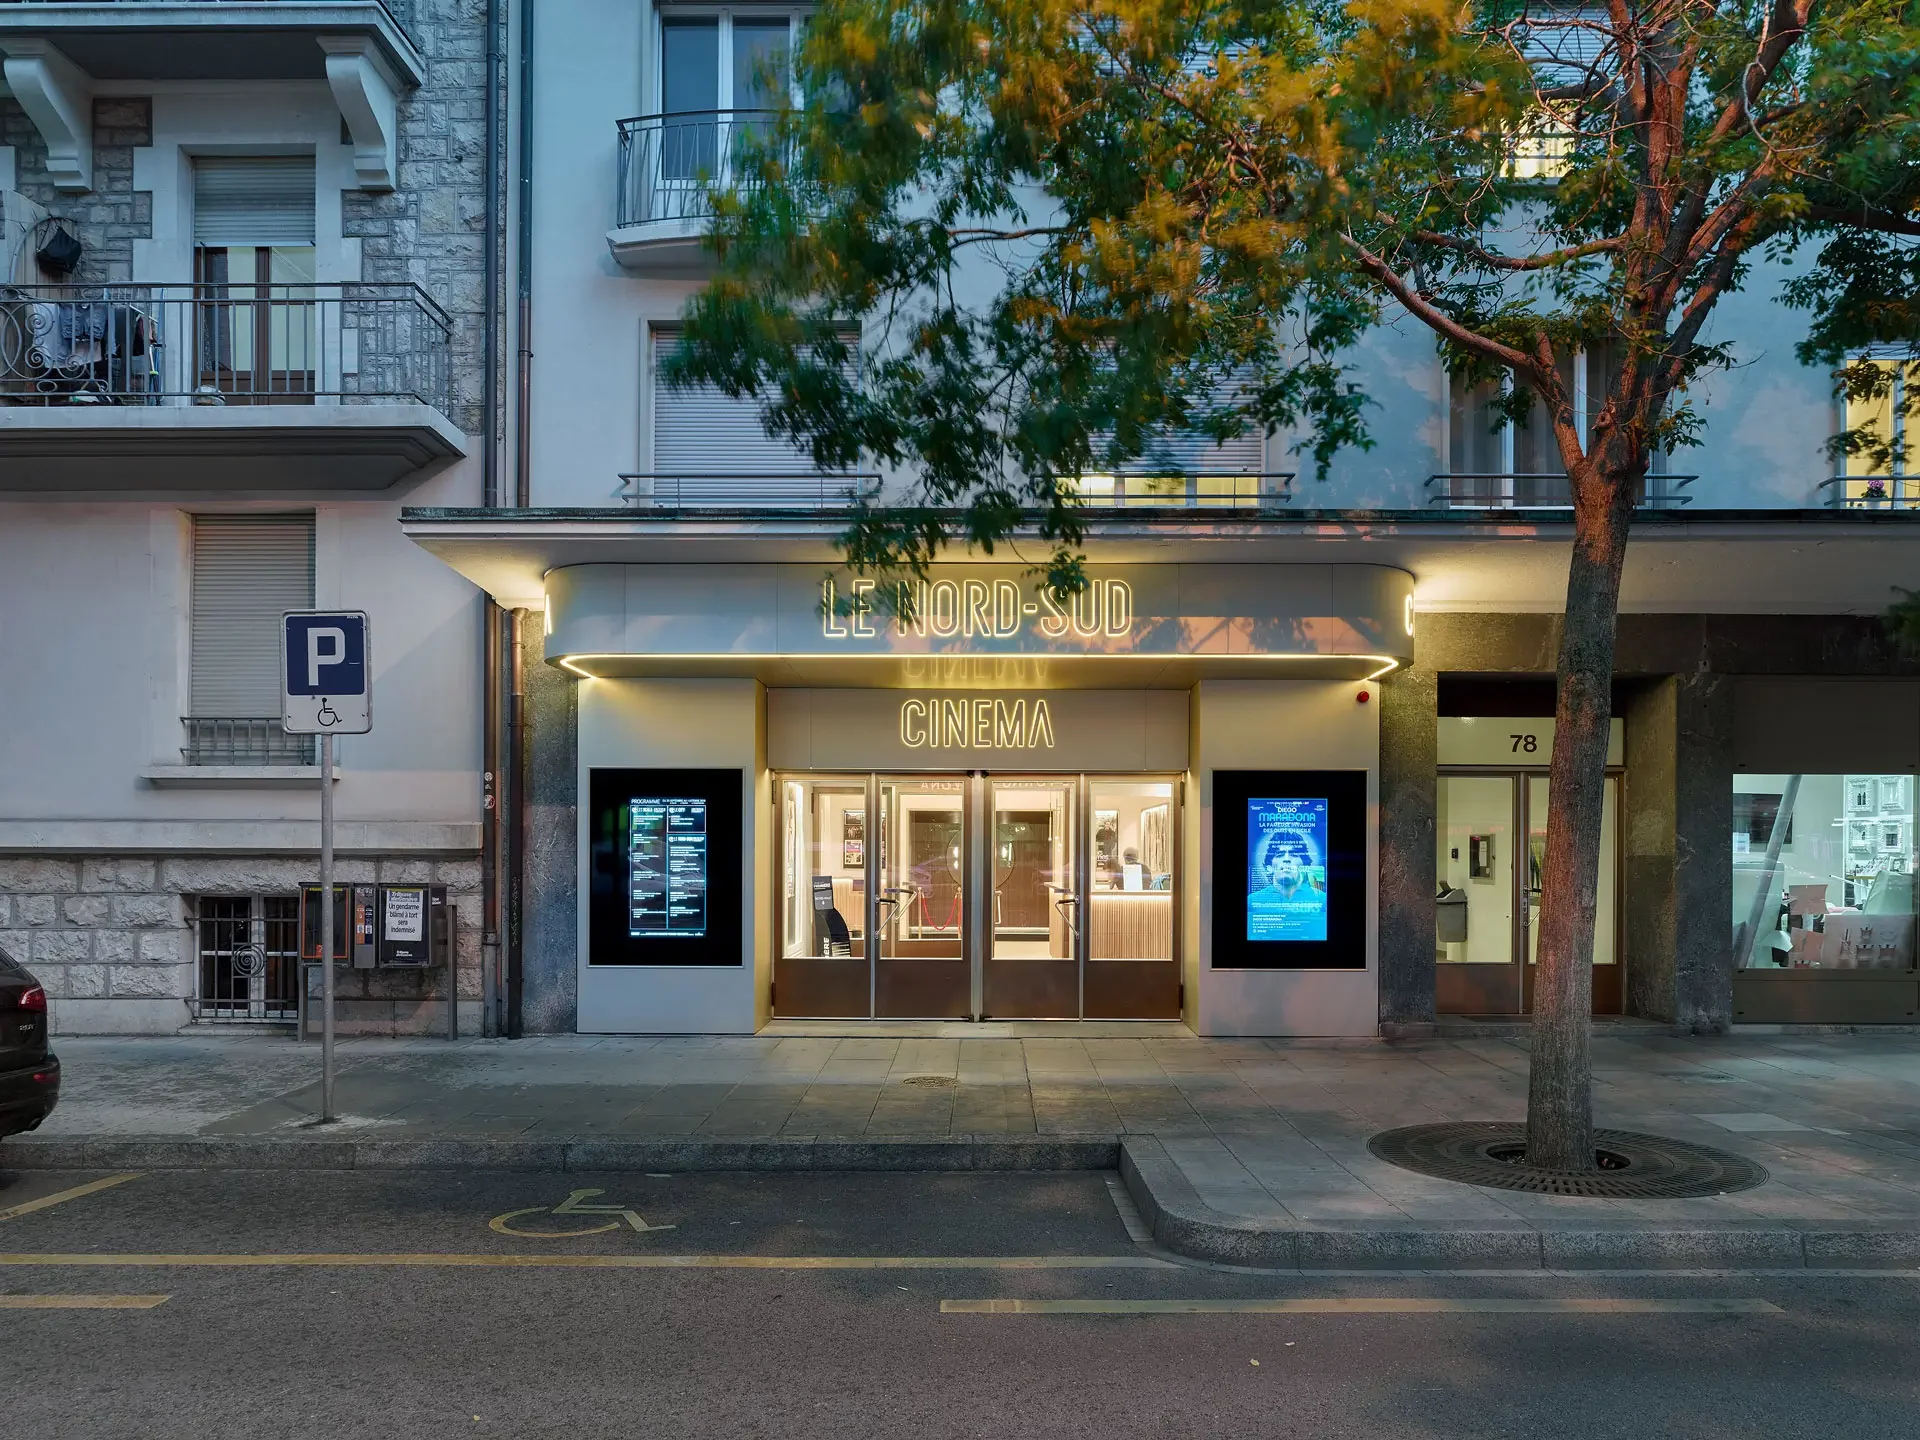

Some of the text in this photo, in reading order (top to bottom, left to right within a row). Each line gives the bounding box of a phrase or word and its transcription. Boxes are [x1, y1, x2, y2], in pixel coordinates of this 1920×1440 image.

[823, 579, 1132, 638] LE NORD-SUD
[308, 628, 345, 685] P
[900, 698, 1055, 749] CINEMA
[1510, 735, 1537, 753] 78
[1259, 813, 1316, 822] MARADONA
